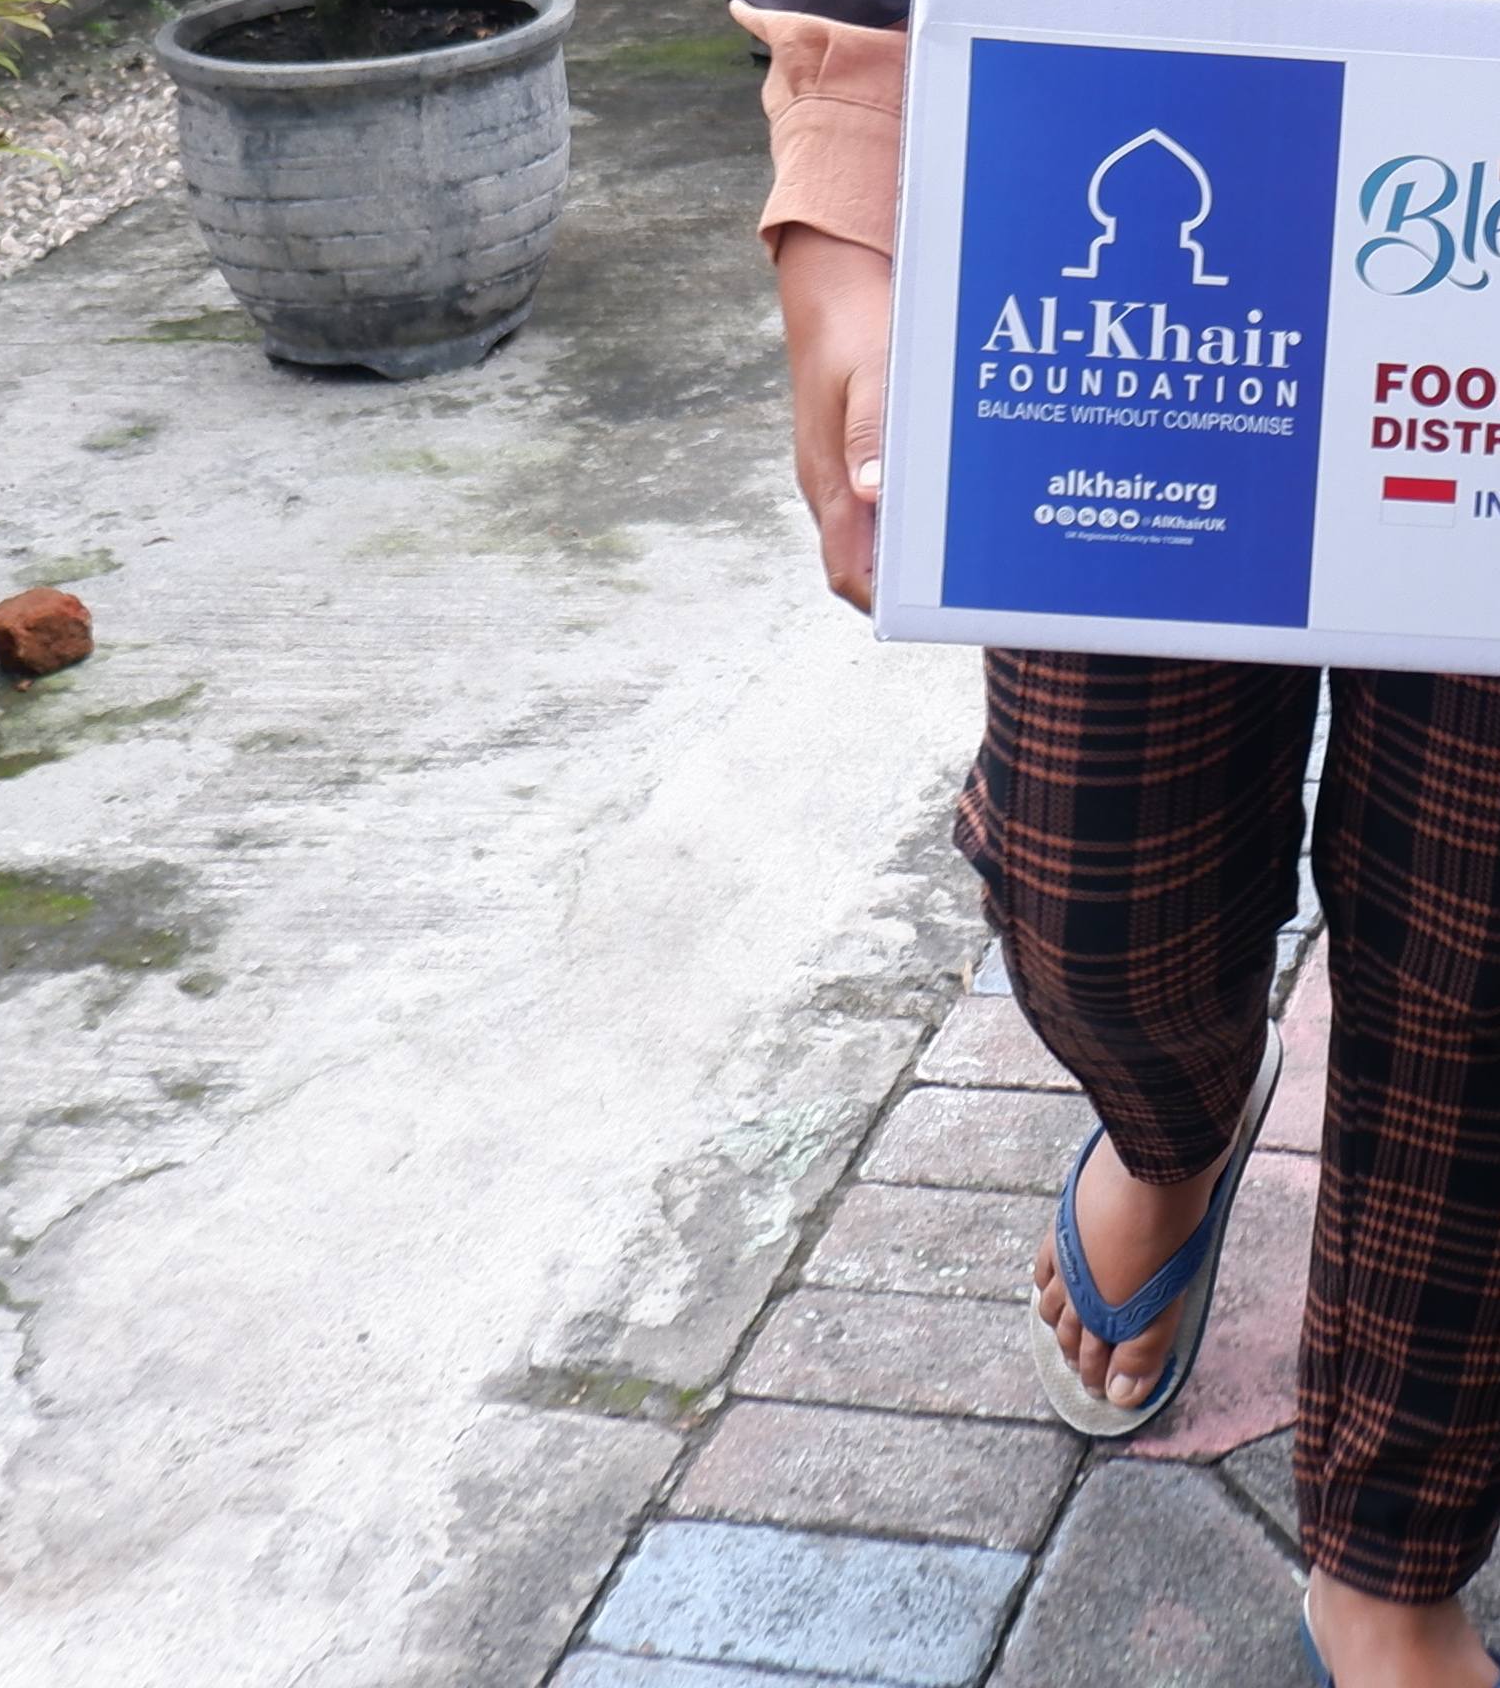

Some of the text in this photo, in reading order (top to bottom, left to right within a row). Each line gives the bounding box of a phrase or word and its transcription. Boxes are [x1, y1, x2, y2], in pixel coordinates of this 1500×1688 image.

[980, 294, 1302, 369] Al-Khair
[978, 362, 1298, 408] FOUNDATION
[977, 399, 1295, 436] BALANCE WITHOUT COMPROMISE
[1048, 469, 1218, 510] alkhair.org
